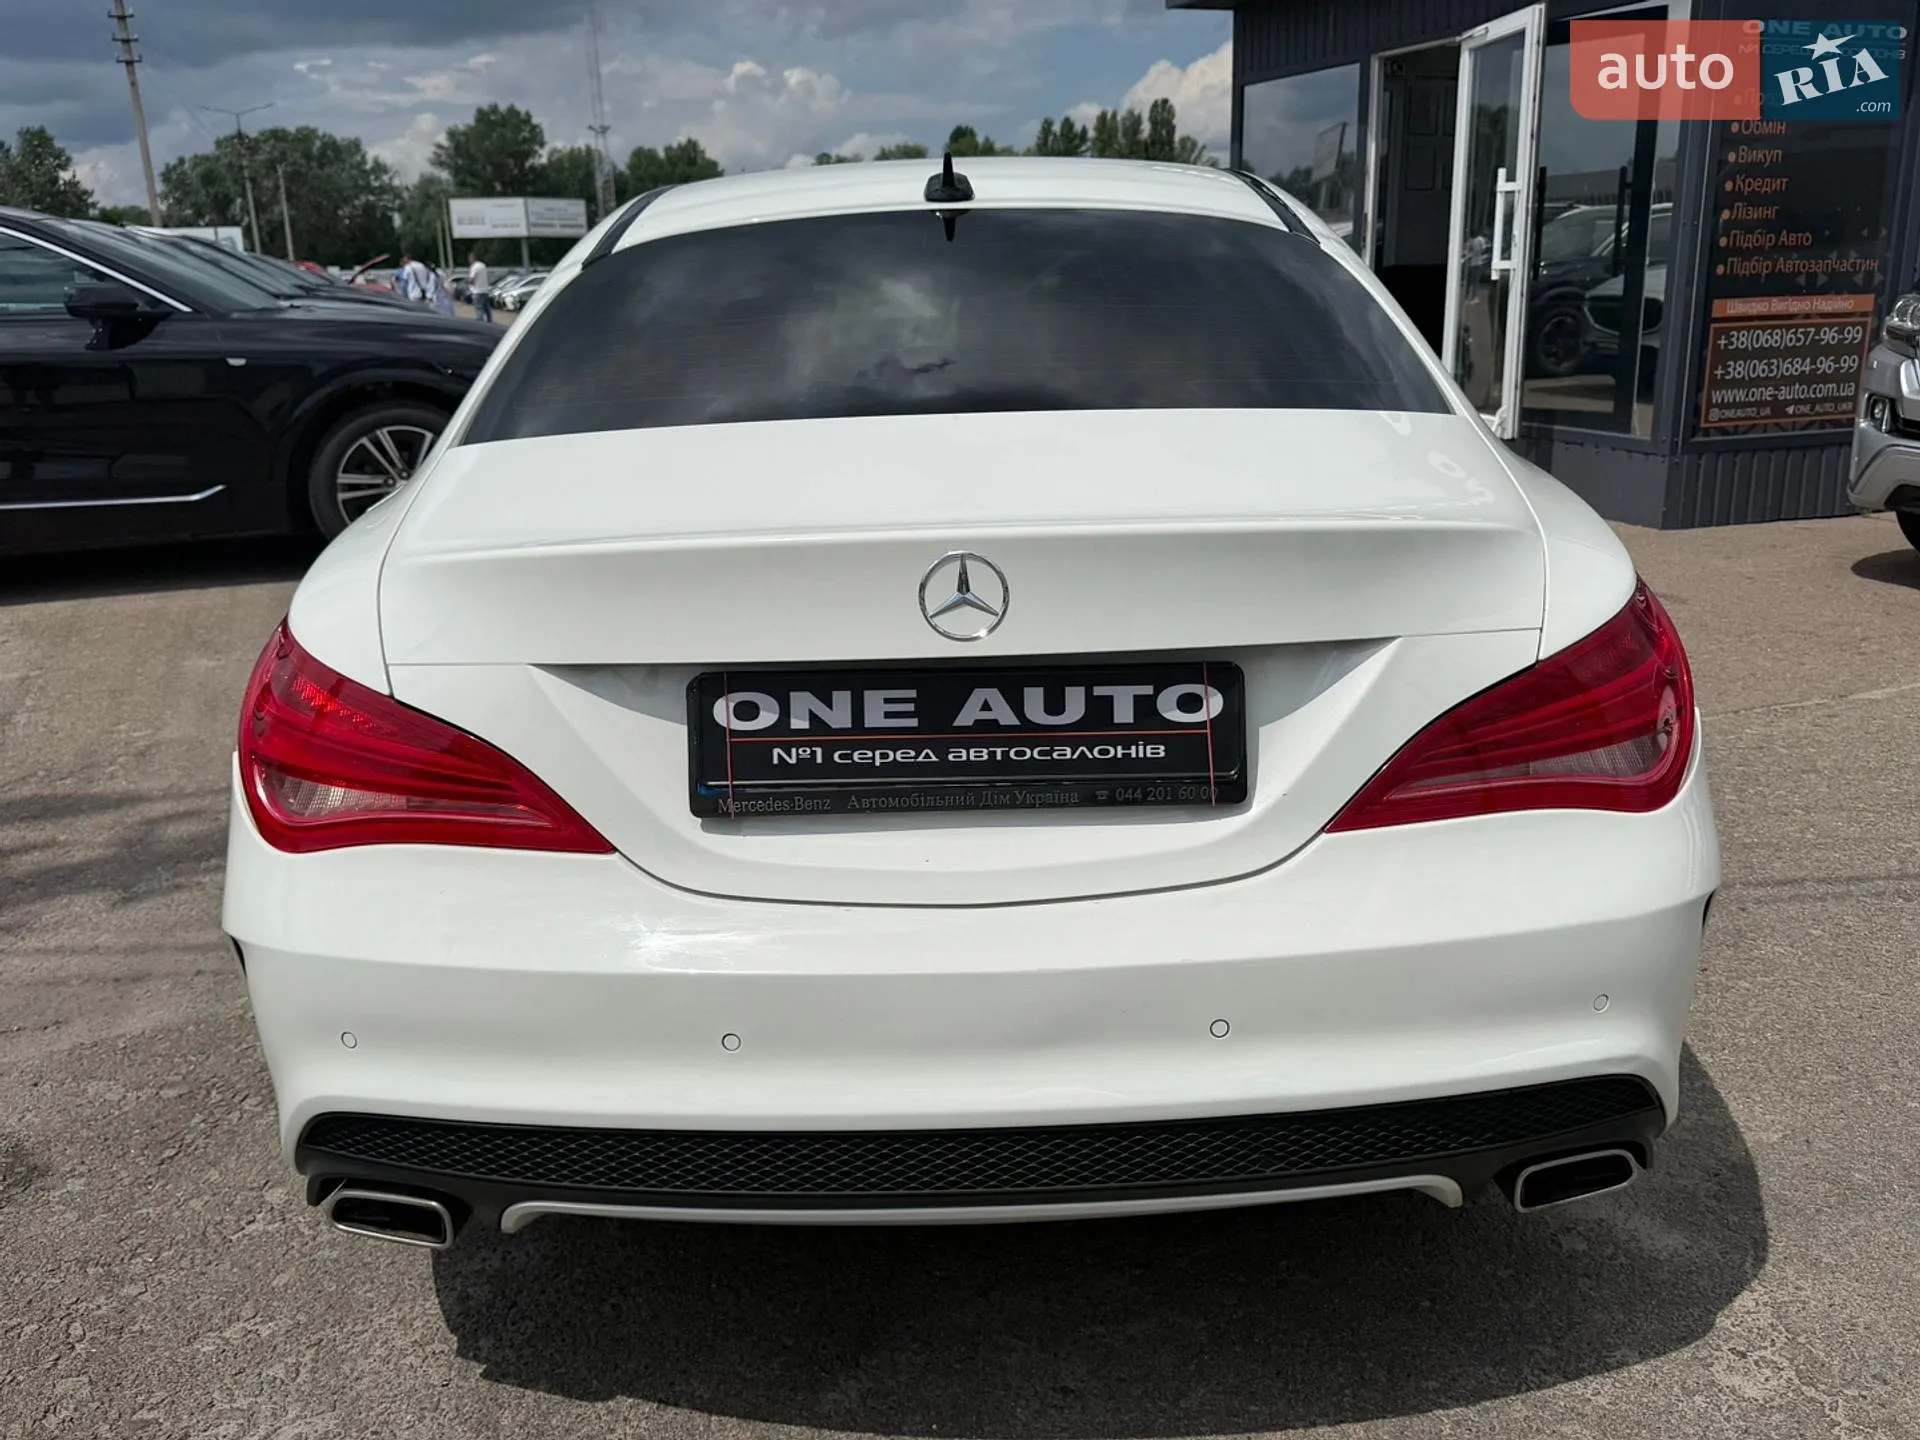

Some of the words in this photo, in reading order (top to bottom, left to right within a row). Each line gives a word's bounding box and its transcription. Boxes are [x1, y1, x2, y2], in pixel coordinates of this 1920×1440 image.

[1742, 20, 1811, 36] ONE
[1822, 23, 1908, 40] AUTO
[1740, 118, 1786, 135] Обмін
[1738, 145, 1782, 167] Викуп
[1734, 174, 1789, 195] Кредит
[1730, 202, 1779, 220] Лізинг
[1729, 230, 1776, 250] Підбір
[1777, 229, 1813, 247] Авто
[1725, 257, 1772, 277] Підбір
[1775, 257, 1879, 275] Автозапчастин
[1717, 326, 1863, 350] +38(068)657-96-99
[1713, 355, 1859, 380] +38(063)684-96-99
[1711, 381, 1856, 403] www.one-auto.com.ua
[712, 689, 919, 732] ONE
[952, 683, 1224, 727] AUTO
[772, 746, 823, 765] №1
[832, 750, 939, 767] серед
[948, 740, 1166, 761] автосалонів
[848, 791, 975, 809] Автомобільний
[980, 790, 1011, 806] Дім
[1013, 788, 1080, 807] Україна
[1115, 787, 1142, 801] 044
[1146, 786, 1172, 800] 201
[1178, 786, 1196, 800] 60
